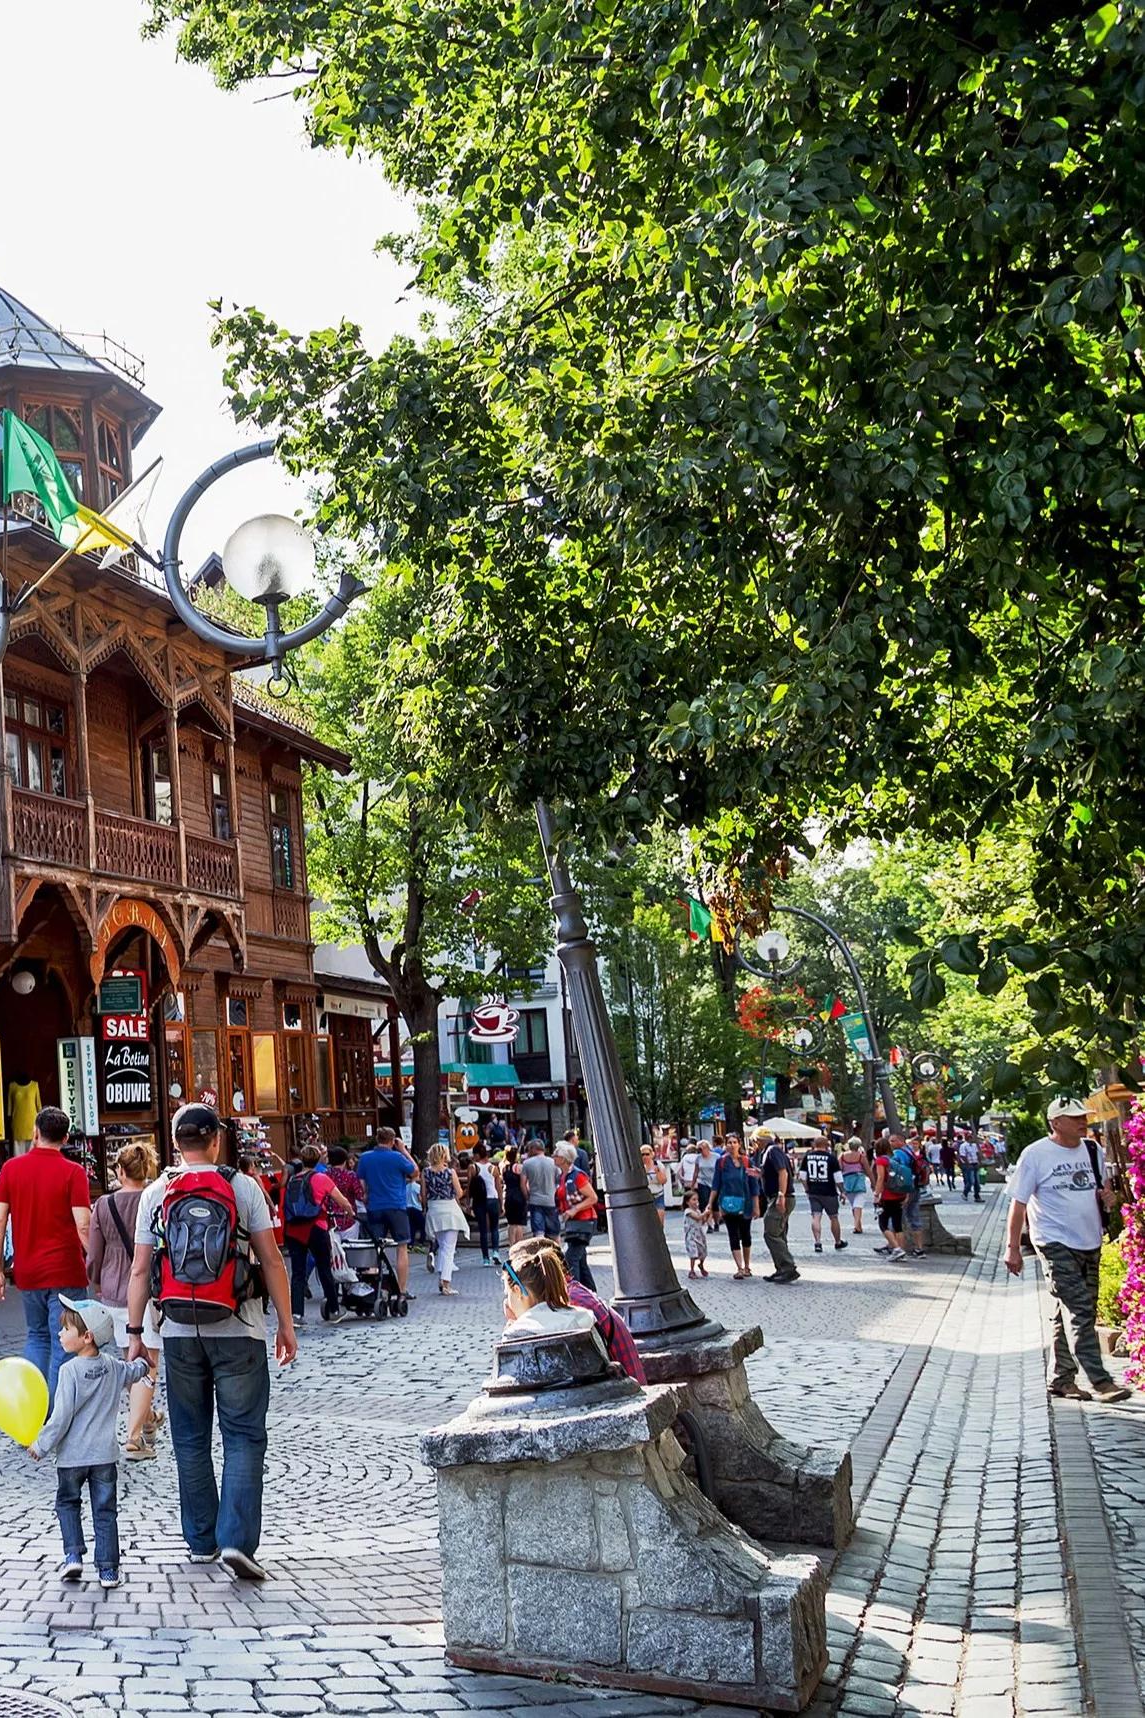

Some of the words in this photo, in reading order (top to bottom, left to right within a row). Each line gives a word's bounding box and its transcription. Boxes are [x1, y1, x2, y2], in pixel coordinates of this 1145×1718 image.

[106, 1018, 147, 1038] SALE
[104, 1044, 121, 1067] La
[105, 1083, 151, 1103] OBUWIE
[807, 1160, 828, 1179] 03
